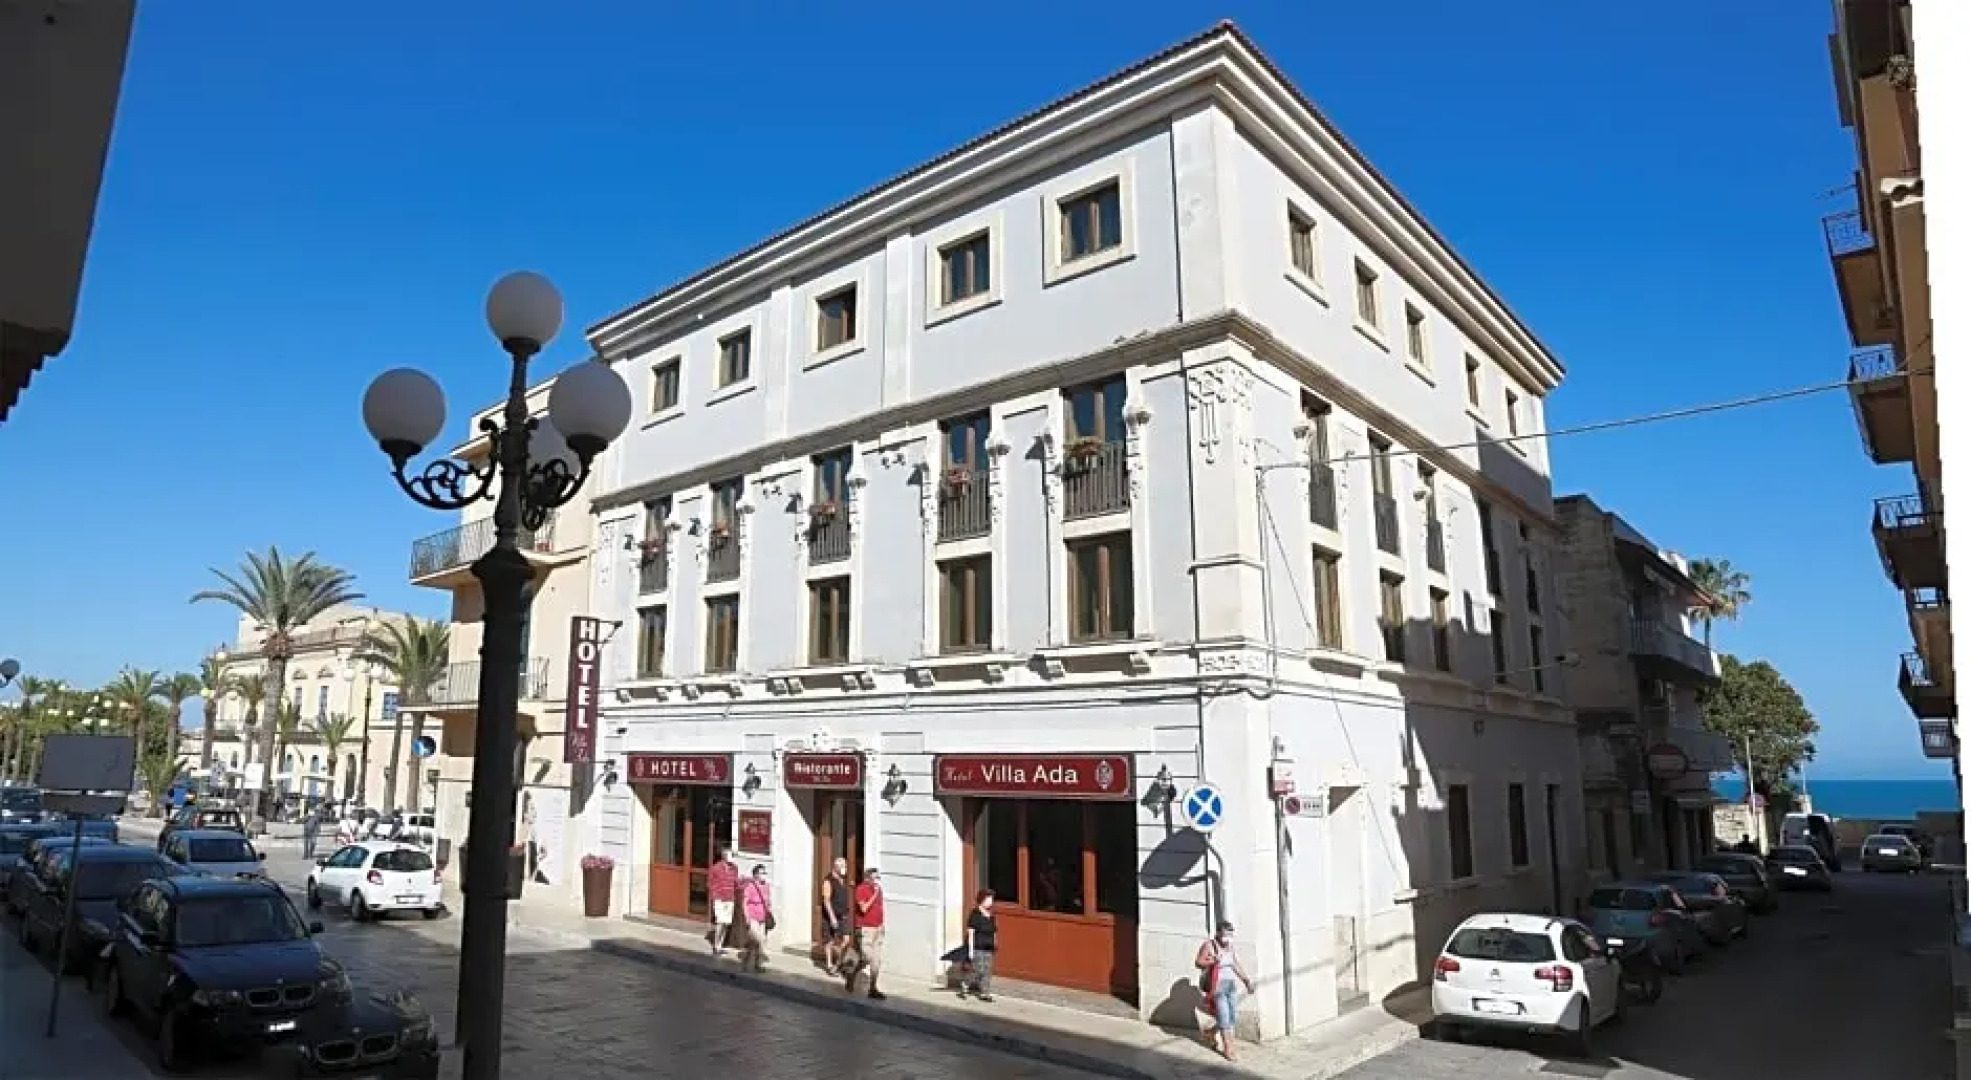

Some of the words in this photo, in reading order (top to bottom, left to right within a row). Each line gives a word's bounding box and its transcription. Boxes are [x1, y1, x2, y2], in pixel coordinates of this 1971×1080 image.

[576, 620, 597, 729] HOTEL
[651, 760, 697, 777] HOTEL
[794, 762, 850, 775] Ristorante
[980, 764, 1026, 783] Villa
[1032, 764, 1079, 783] Ada
